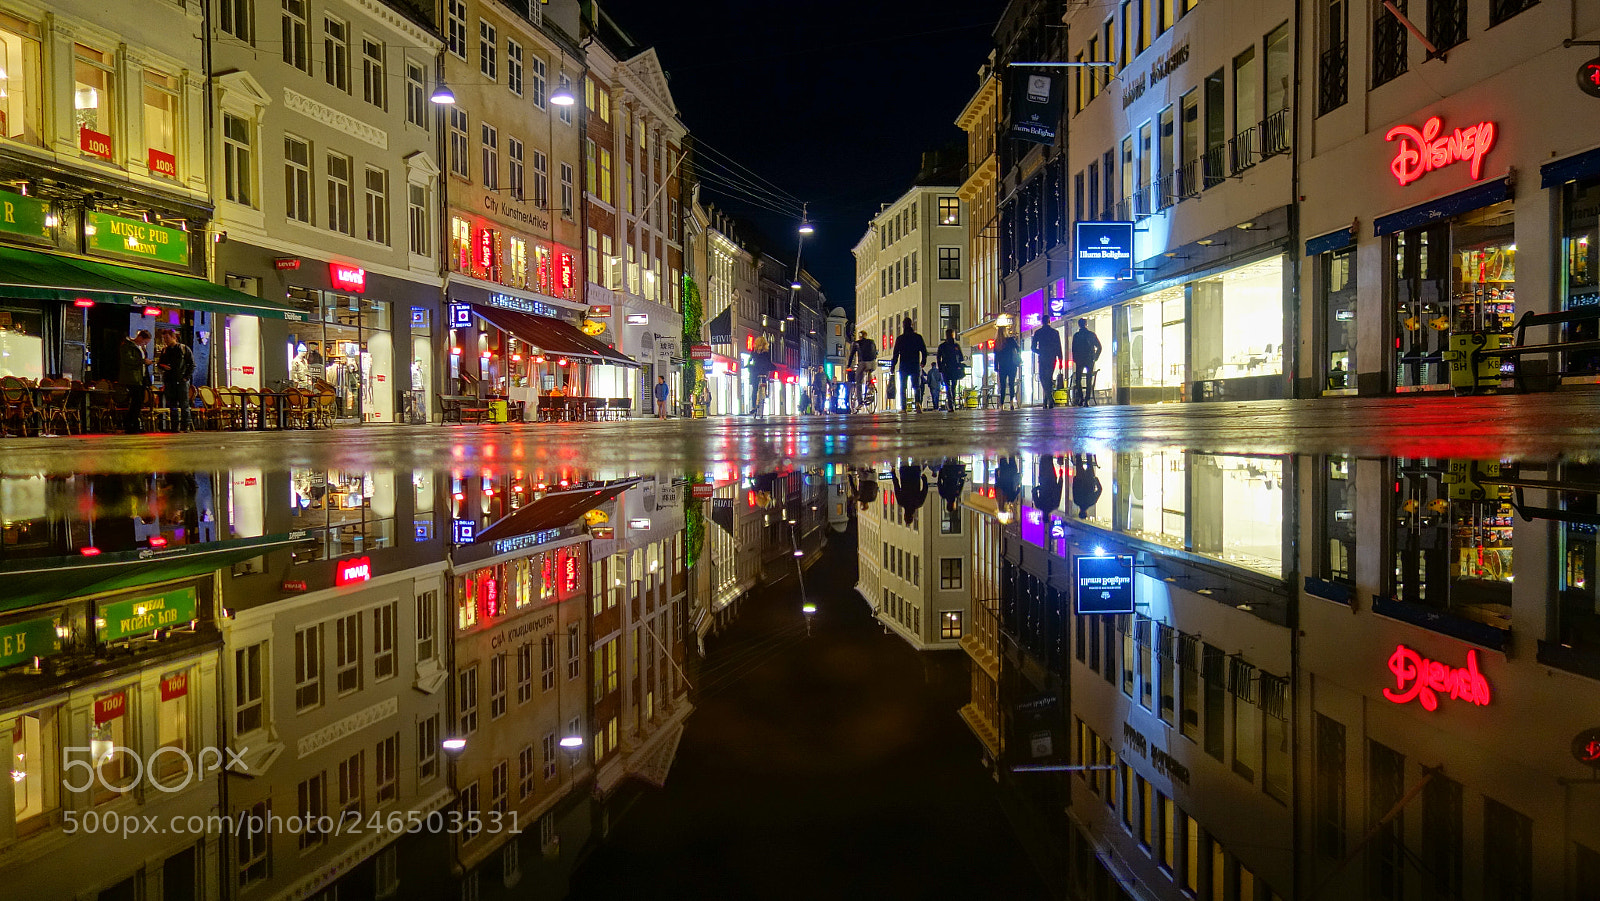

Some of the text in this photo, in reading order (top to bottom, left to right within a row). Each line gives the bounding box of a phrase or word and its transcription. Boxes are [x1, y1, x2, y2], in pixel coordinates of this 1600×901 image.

[485, 195, 498, 215] City
[110, 220, 169, 245] MUSIC PUB
[1079, 250, 1101, 258] Illums
